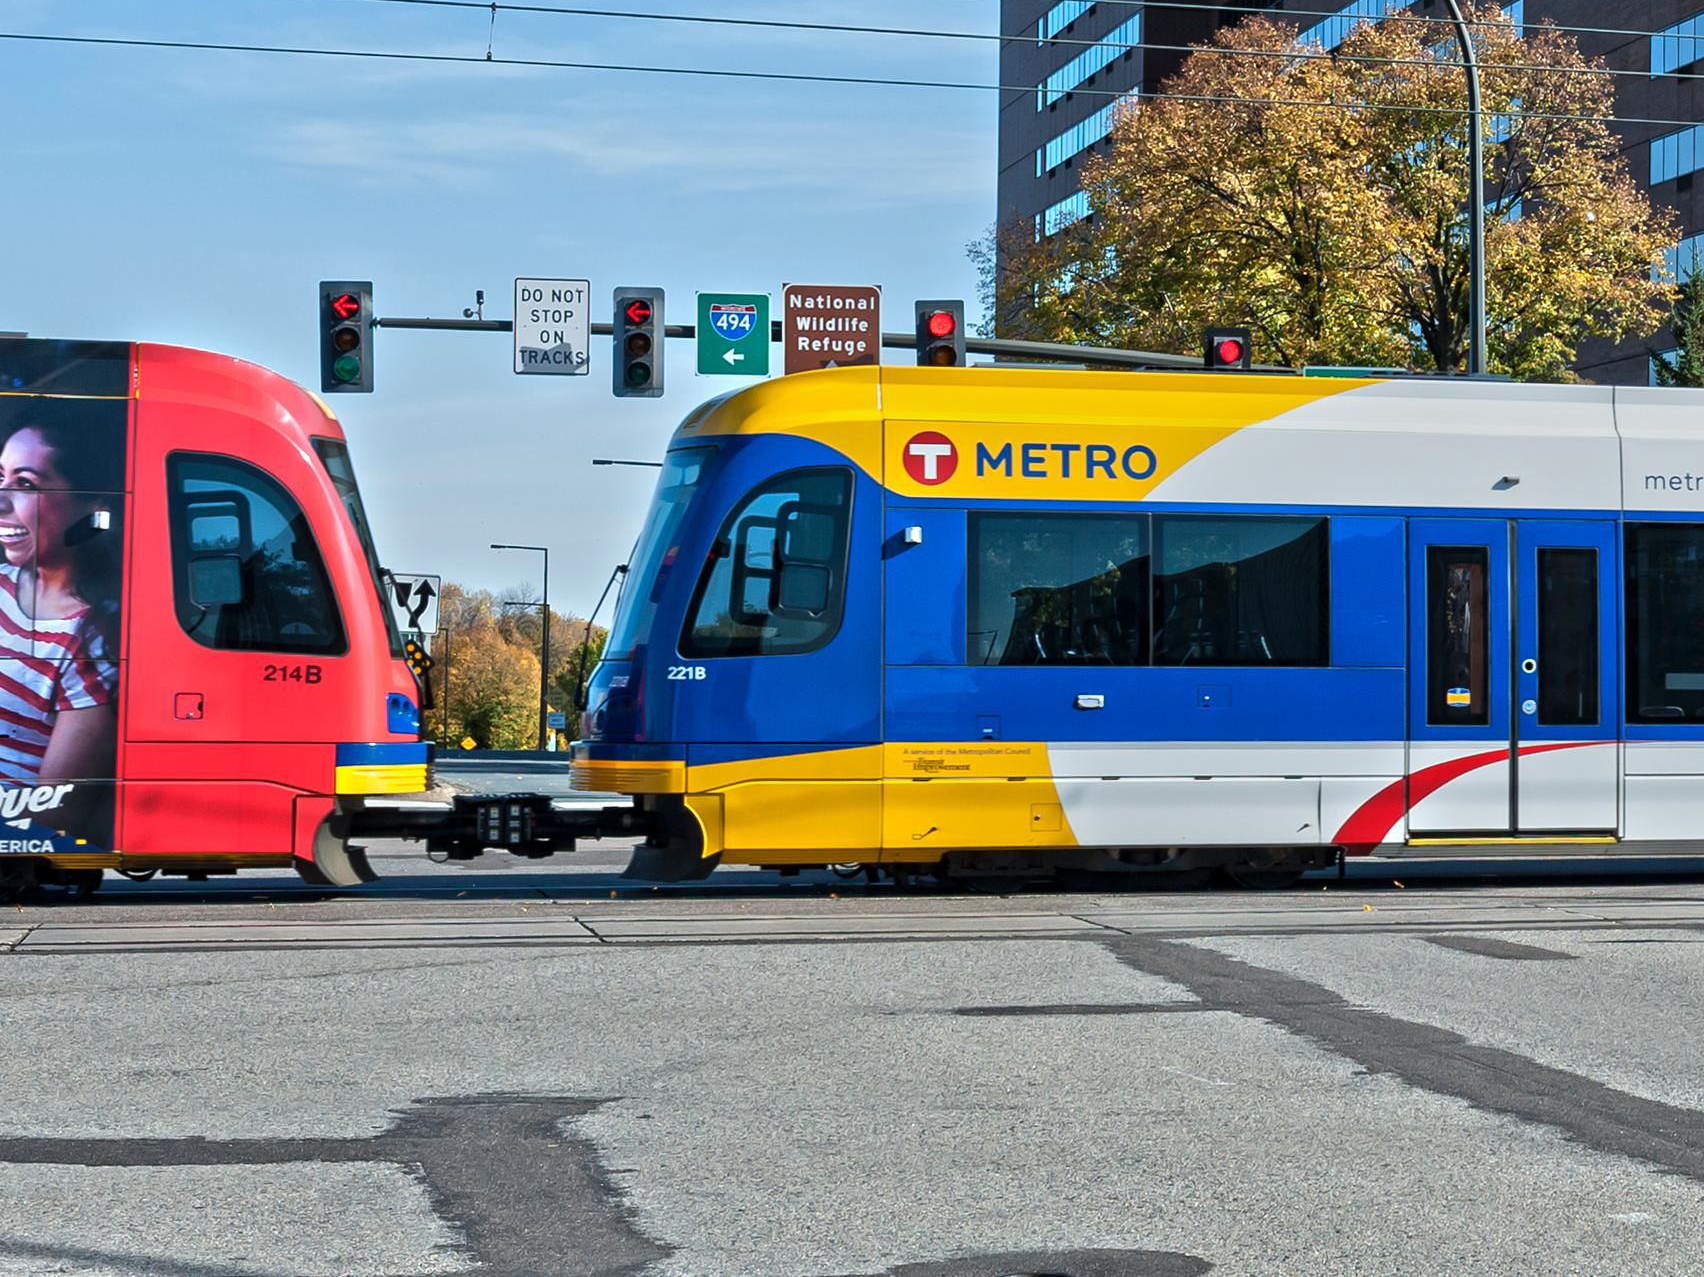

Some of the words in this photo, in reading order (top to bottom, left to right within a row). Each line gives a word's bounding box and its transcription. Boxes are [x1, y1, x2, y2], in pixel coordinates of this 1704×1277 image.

[521, 288, 543, 302] DO
[552, 289, 584, 303] NOT
[789, 294, 875, 310] National
[530, 309, 574, 323] STOP
[716, 314, 751, 331] 494
[796, 316, 869, 332] Wildlife
[540, 330, 564, 344] ON
[797, 337, 867, 356] Refuge
[519, 349, 585, 365] TRACKS
[976, 441, 1157, 481] METRO
[263, 664, 322, 684] 214B
[667, 666, 706, 680] 221B
